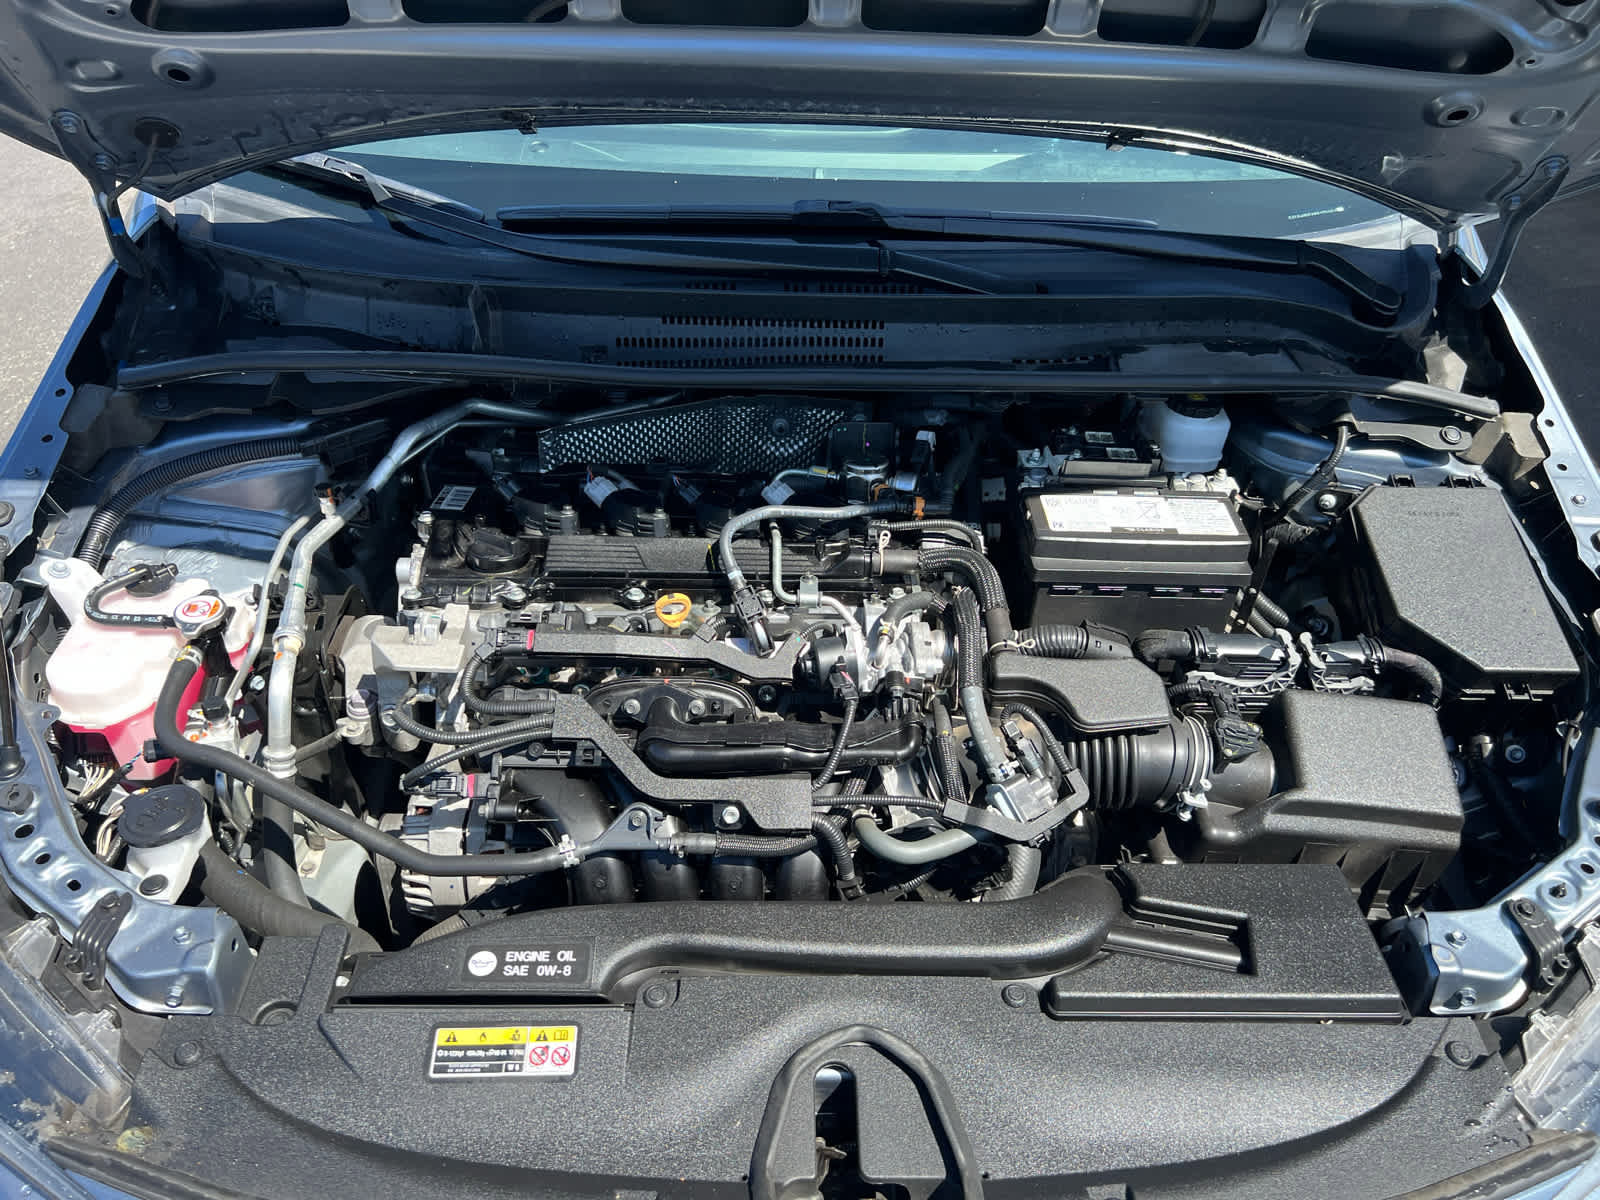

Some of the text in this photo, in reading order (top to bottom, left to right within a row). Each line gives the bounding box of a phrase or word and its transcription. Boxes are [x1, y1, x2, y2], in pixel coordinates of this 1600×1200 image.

[505, 950, 577, 962] ENGINE OIL
[503, 965, 572, 976] SAE 0W-8
